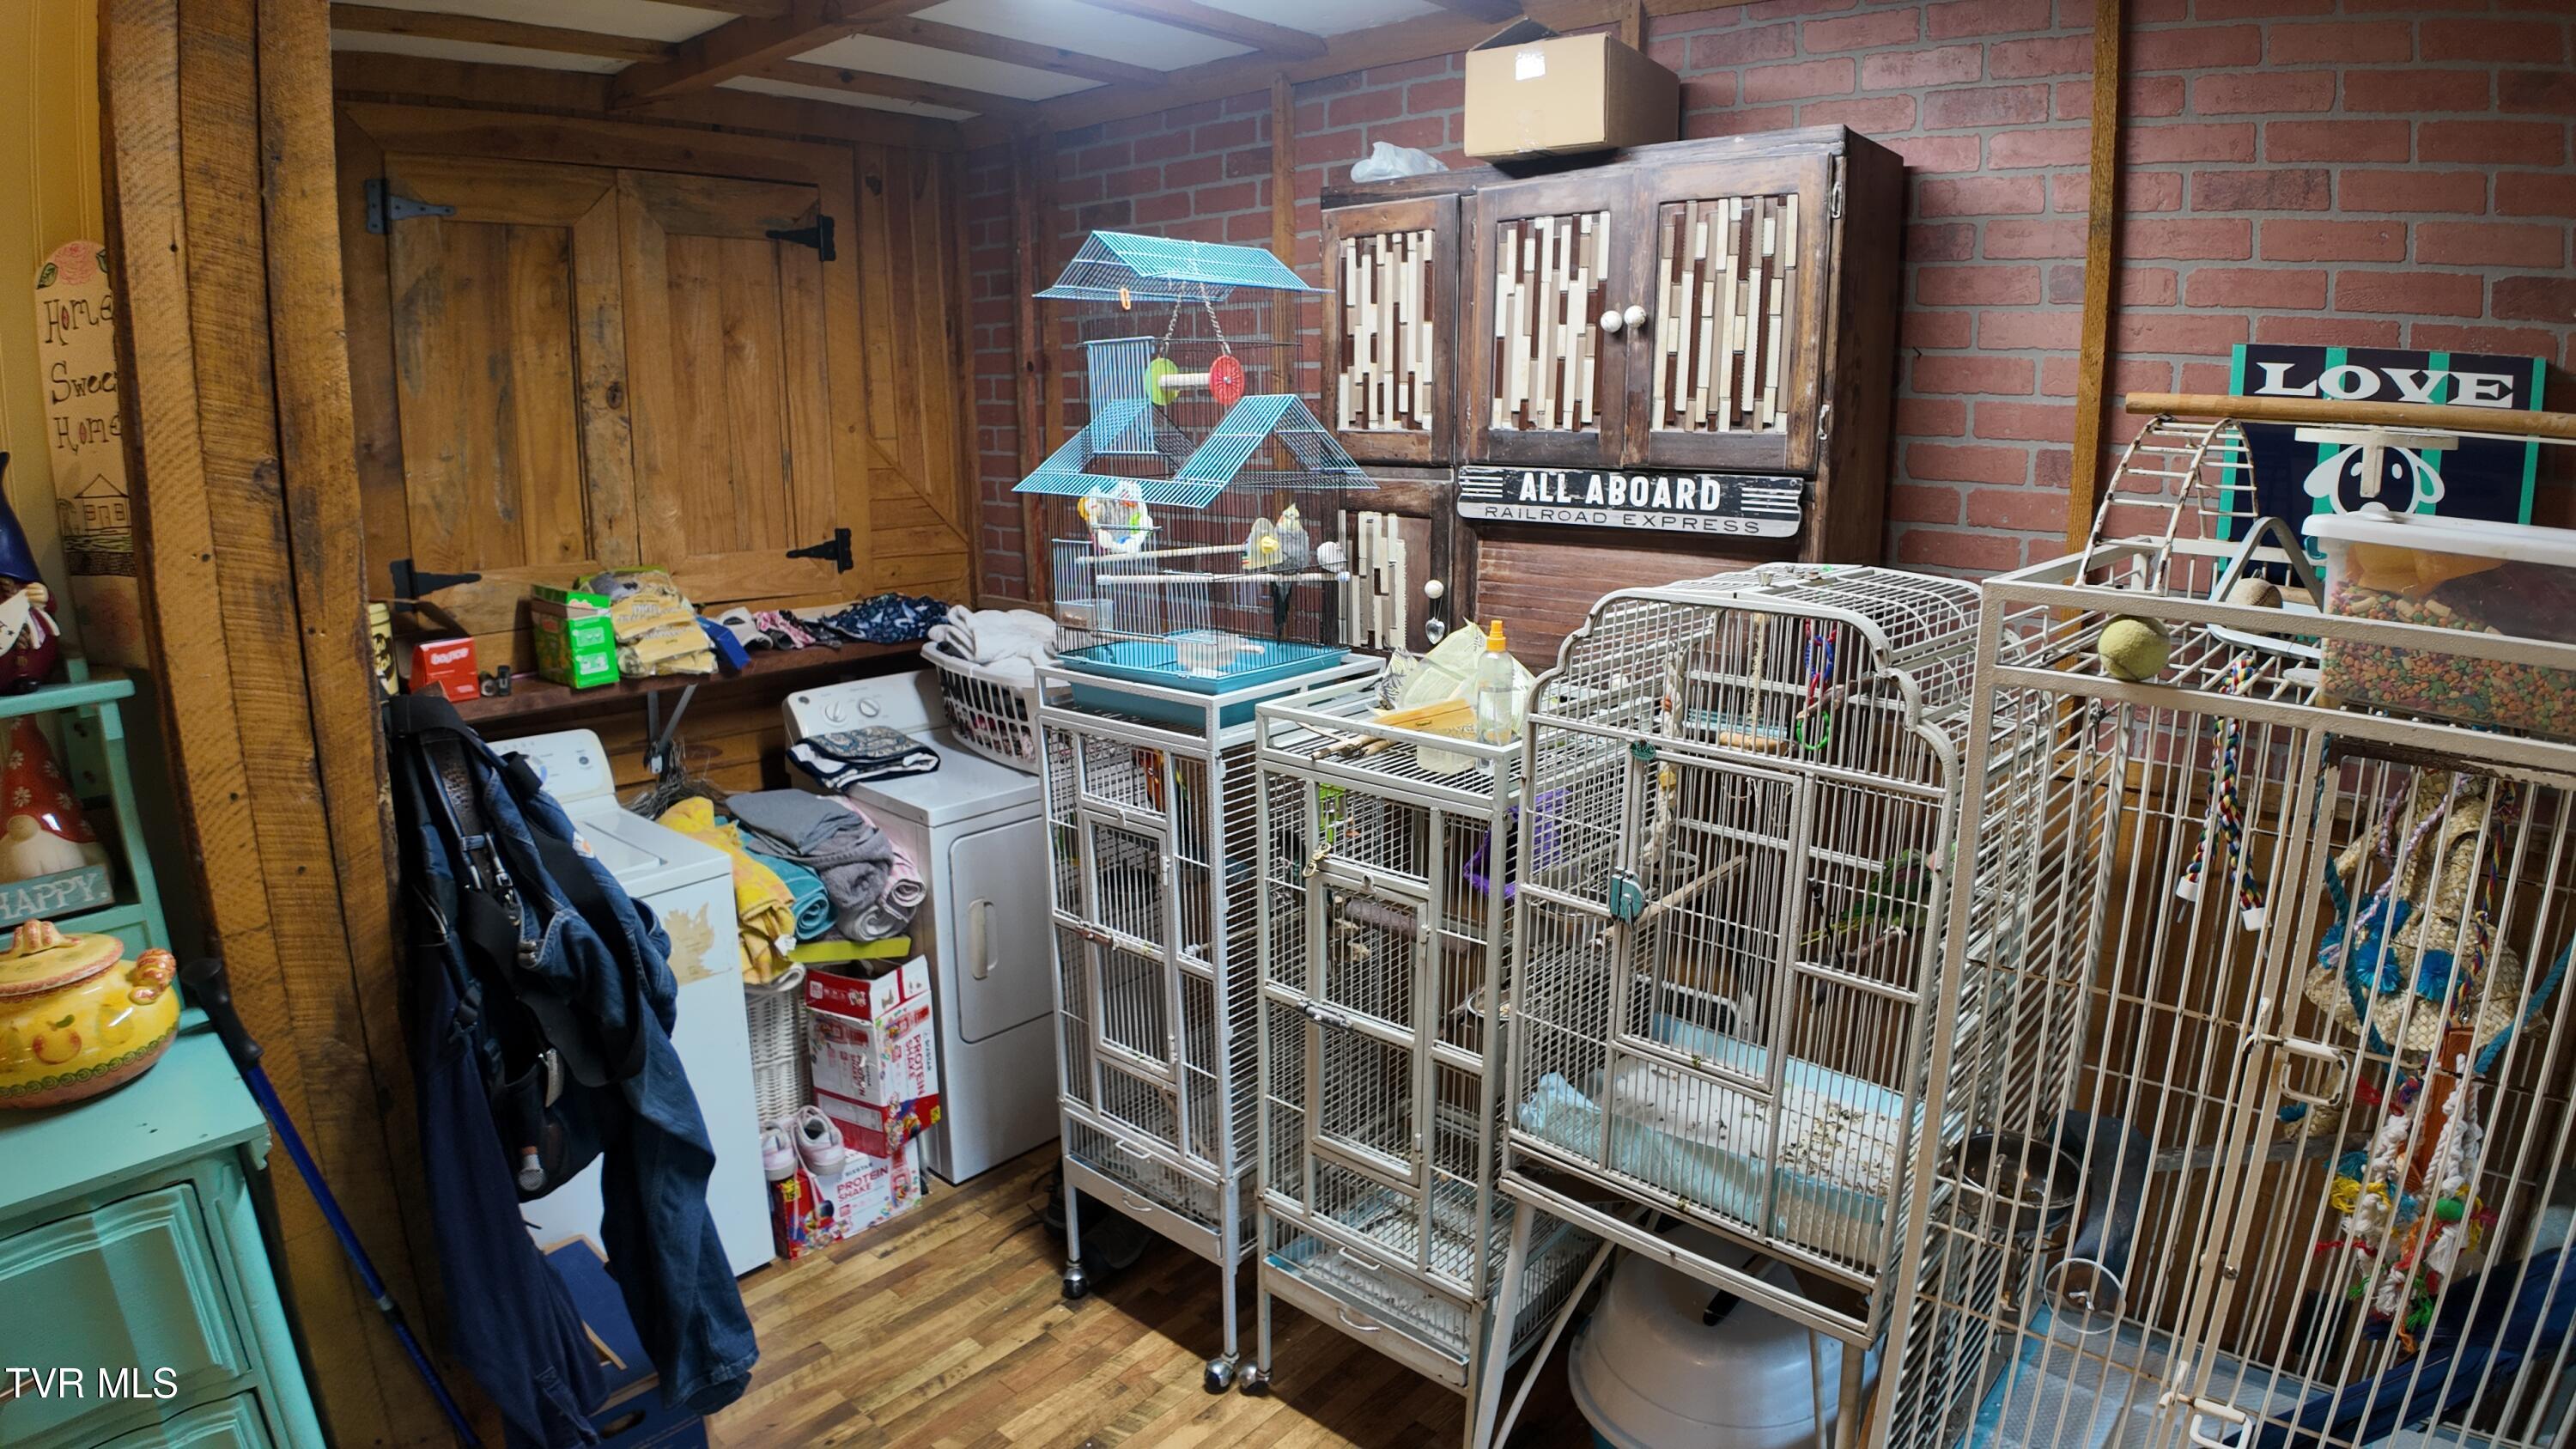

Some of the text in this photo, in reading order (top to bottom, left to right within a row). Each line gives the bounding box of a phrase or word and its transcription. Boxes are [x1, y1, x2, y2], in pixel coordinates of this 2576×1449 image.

[52, 361, 118, 405] Swee
[2253, 361, 2514, 409] LOVE
[1519, 472, 1720, 511] ALL ABOARD
[1485, 506, 1760, 534] RAILROAD EXPRESS
[913, 1034, 926, 1096] PROTEIN
[836, 1165, 888, 1194] PROTEIN
